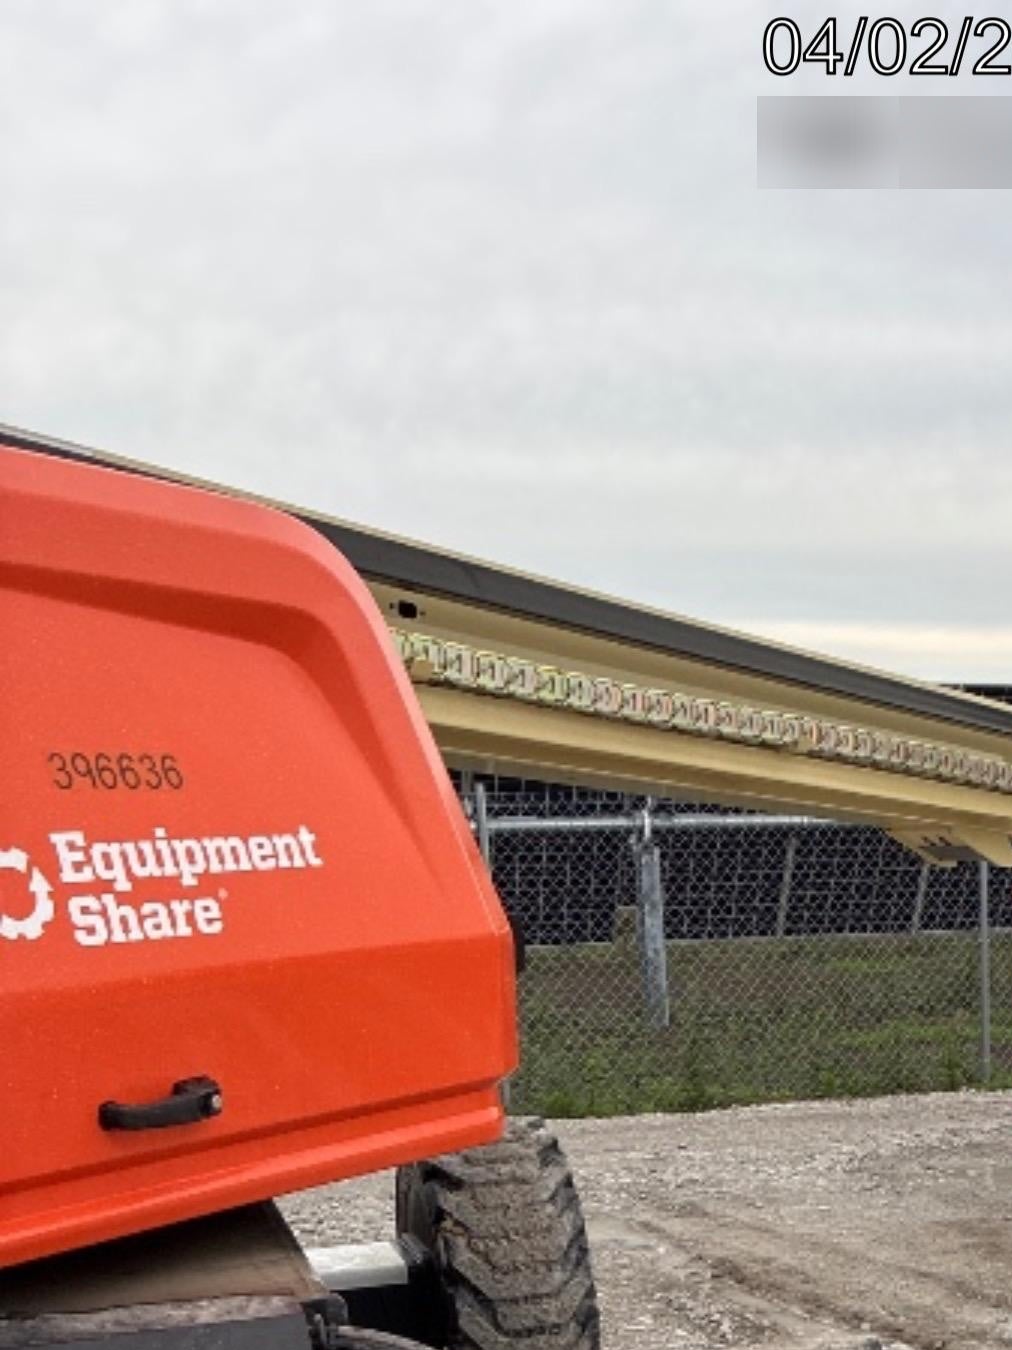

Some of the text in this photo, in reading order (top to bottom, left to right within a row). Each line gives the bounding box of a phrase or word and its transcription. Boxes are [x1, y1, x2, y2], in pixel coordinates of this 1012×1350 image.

[48, 752, 184, 790] 396636
[49, 825, 323, 891] Equipment
[67, 893, 223, 946] Share
